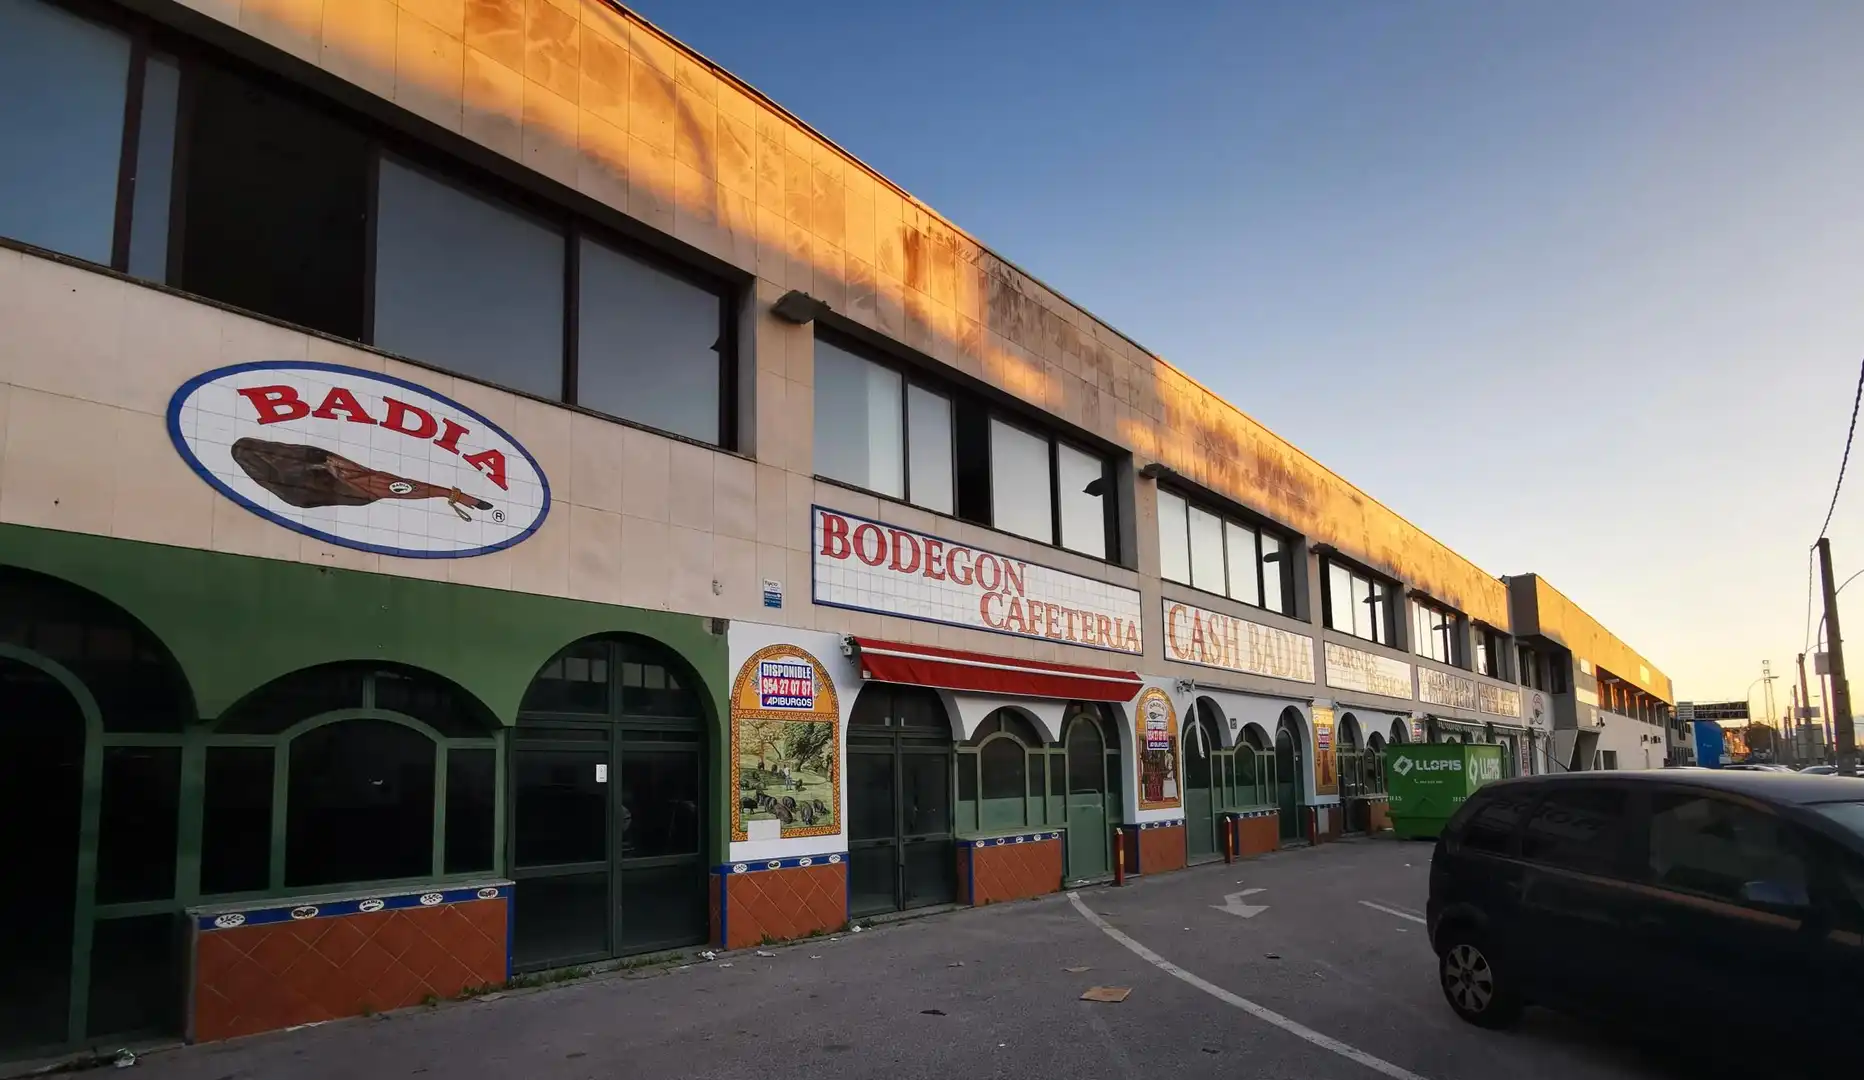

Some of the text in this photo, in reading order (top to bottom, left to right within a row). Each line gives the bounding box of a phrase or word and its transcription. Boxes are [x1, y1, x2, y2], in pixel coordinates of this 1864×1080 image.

[237, 385, 508, 491] BADIA
[820, 512, 1026, 598] BODEGON
[980, 591, 1143, 652] CAFETERIA
[1169, 603, 1312, 681] CASH BADIA
[763, 663, 811, 679] DISPONIBLE
[766, 696, 812, 707] APIBURGOS
[1416, 760, 1462, 771] LLOPIS
